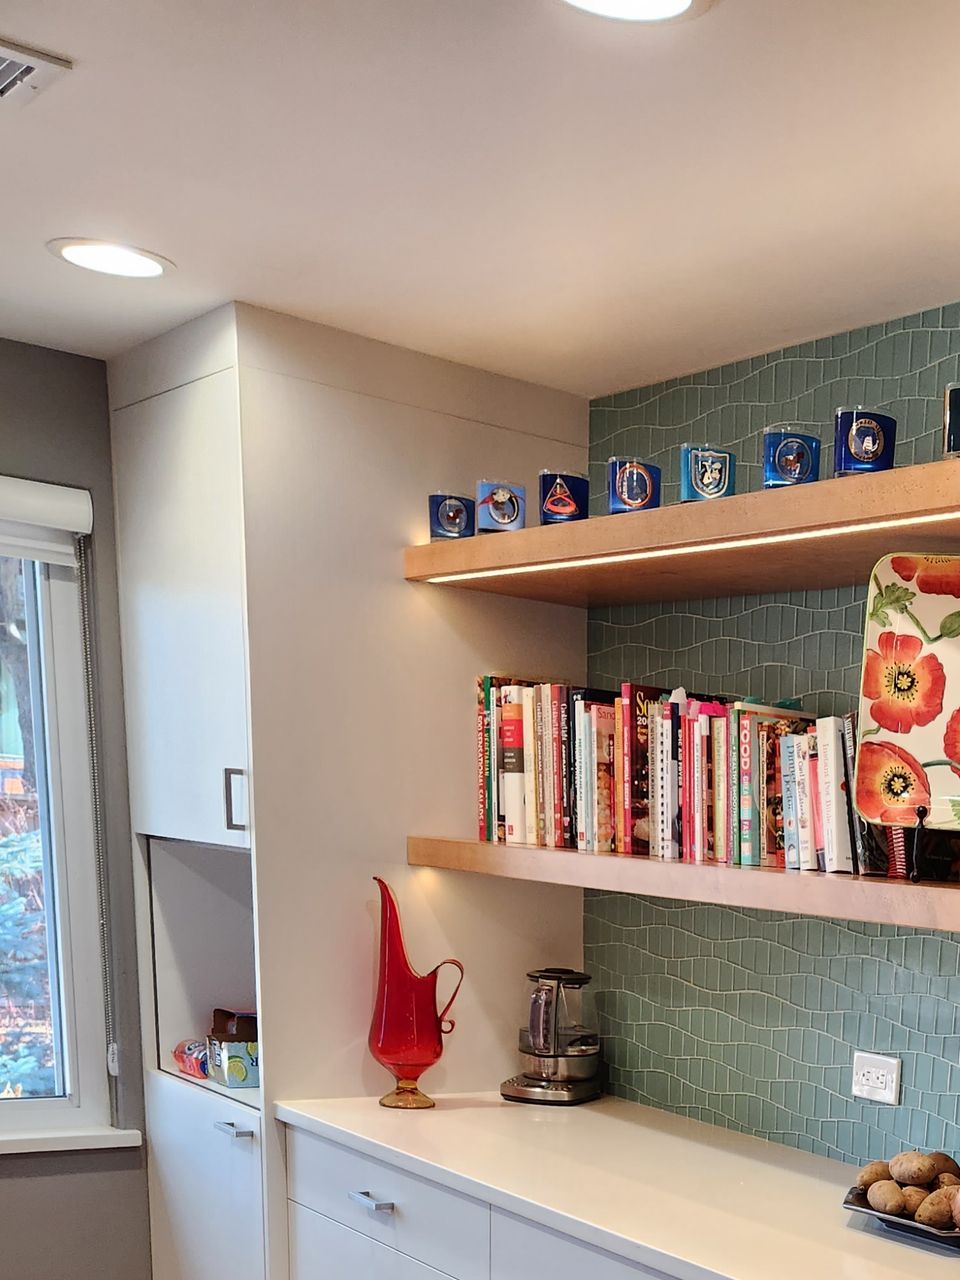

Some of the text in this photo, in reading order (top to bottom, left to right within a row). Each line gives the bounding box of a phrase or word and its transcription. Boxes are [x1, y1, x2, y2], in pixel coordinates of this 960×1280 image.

[740, 719, 751, 770] FOOD
[822, 743, 830, 776] Instant
[786, 744, 796, 784] Dinner
[782, 773, 794, 810] Doctor
